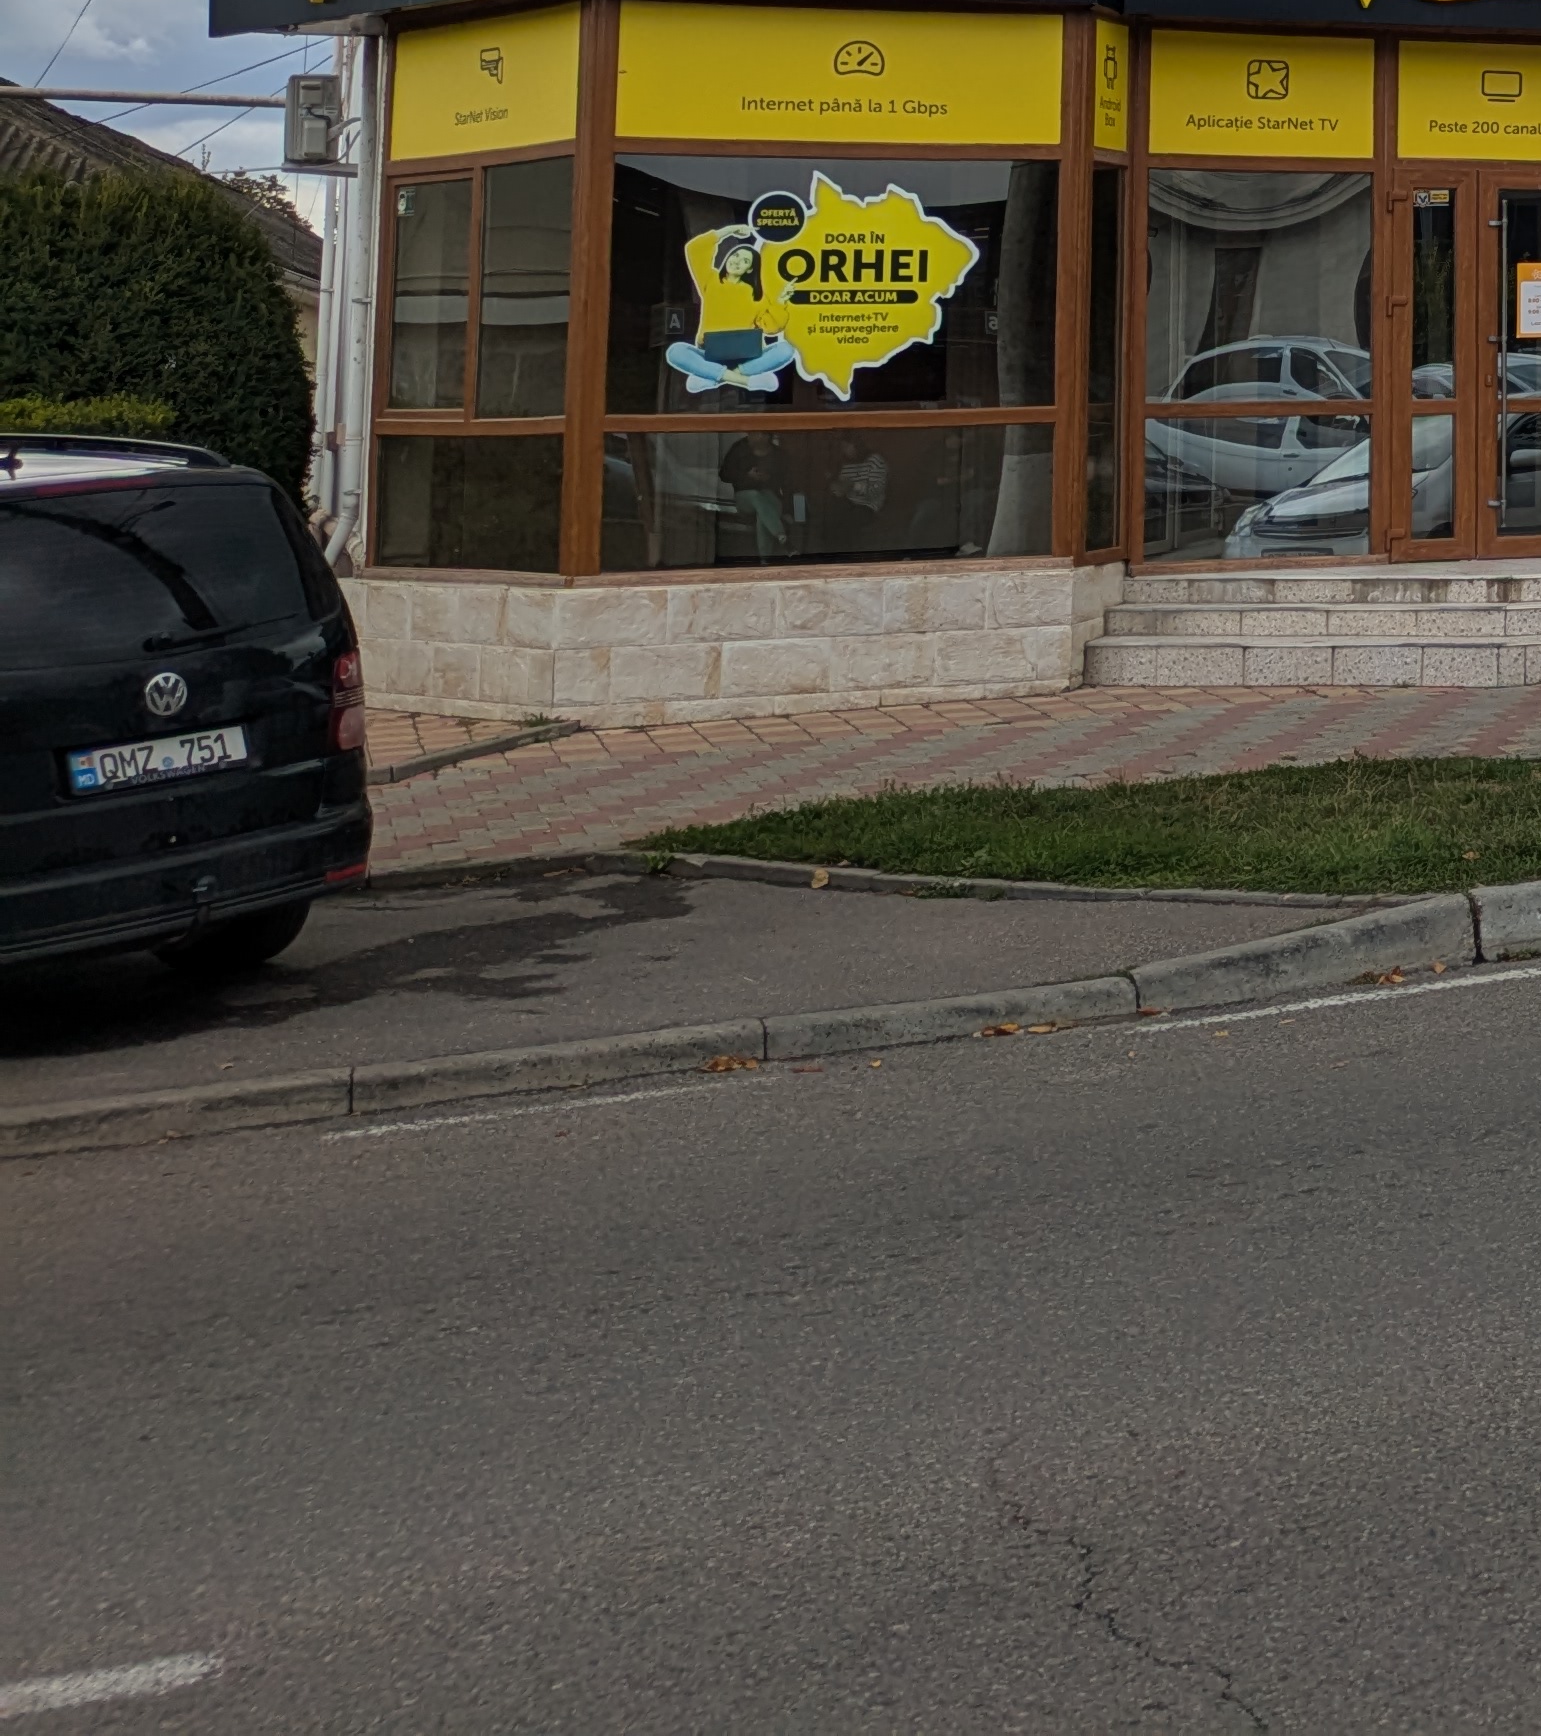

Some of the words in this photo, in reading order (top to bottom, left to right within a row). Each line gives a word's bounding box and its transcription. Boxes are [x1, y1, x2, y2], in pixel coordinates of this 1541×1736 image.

[741, 97, 814, 112] Internet
[819, 98, 863, 116] până
[868, 99, 883, 113] la
[888, 100, 897, 114] 1
[902, 100, 948, 118] Gbps
[1100, 97, 1121, 112] Android
[455, 110, 484, 126] StarNet
[485, 107, 509, 121] Vision
[1186, 114, 1254, 132] Aplicație
[1257, 116, 1314, 131] StarNet
[1318, 118, 1339, 132] TV
[1429, 120, 1468, 134] Peste
[1472, 121, 1500, 134] 200
[760, 208, 796, 218] OFERTĂ
[757, 217, 799, 227] SPECIALĂ
[824, 233, 866, 244] DOAR
[869, 231, 885, 244] ÎN
[778, 249, 929, 283] ORHEI
[809, 292, 851, 302] DOAR
[854, 292, 898, 302] ACUM
[818, 312, 889, 322] Internet+TV
[819, 324, 899, 335] supraveghere
[836, 335, 870, 344] video
[100, 745, 158, 780] QMZ
[179, 732, 232, 768] 751
[78, 773, 95, 787] MD
[130, 764, 207, 784] VOLKSWAGEN
